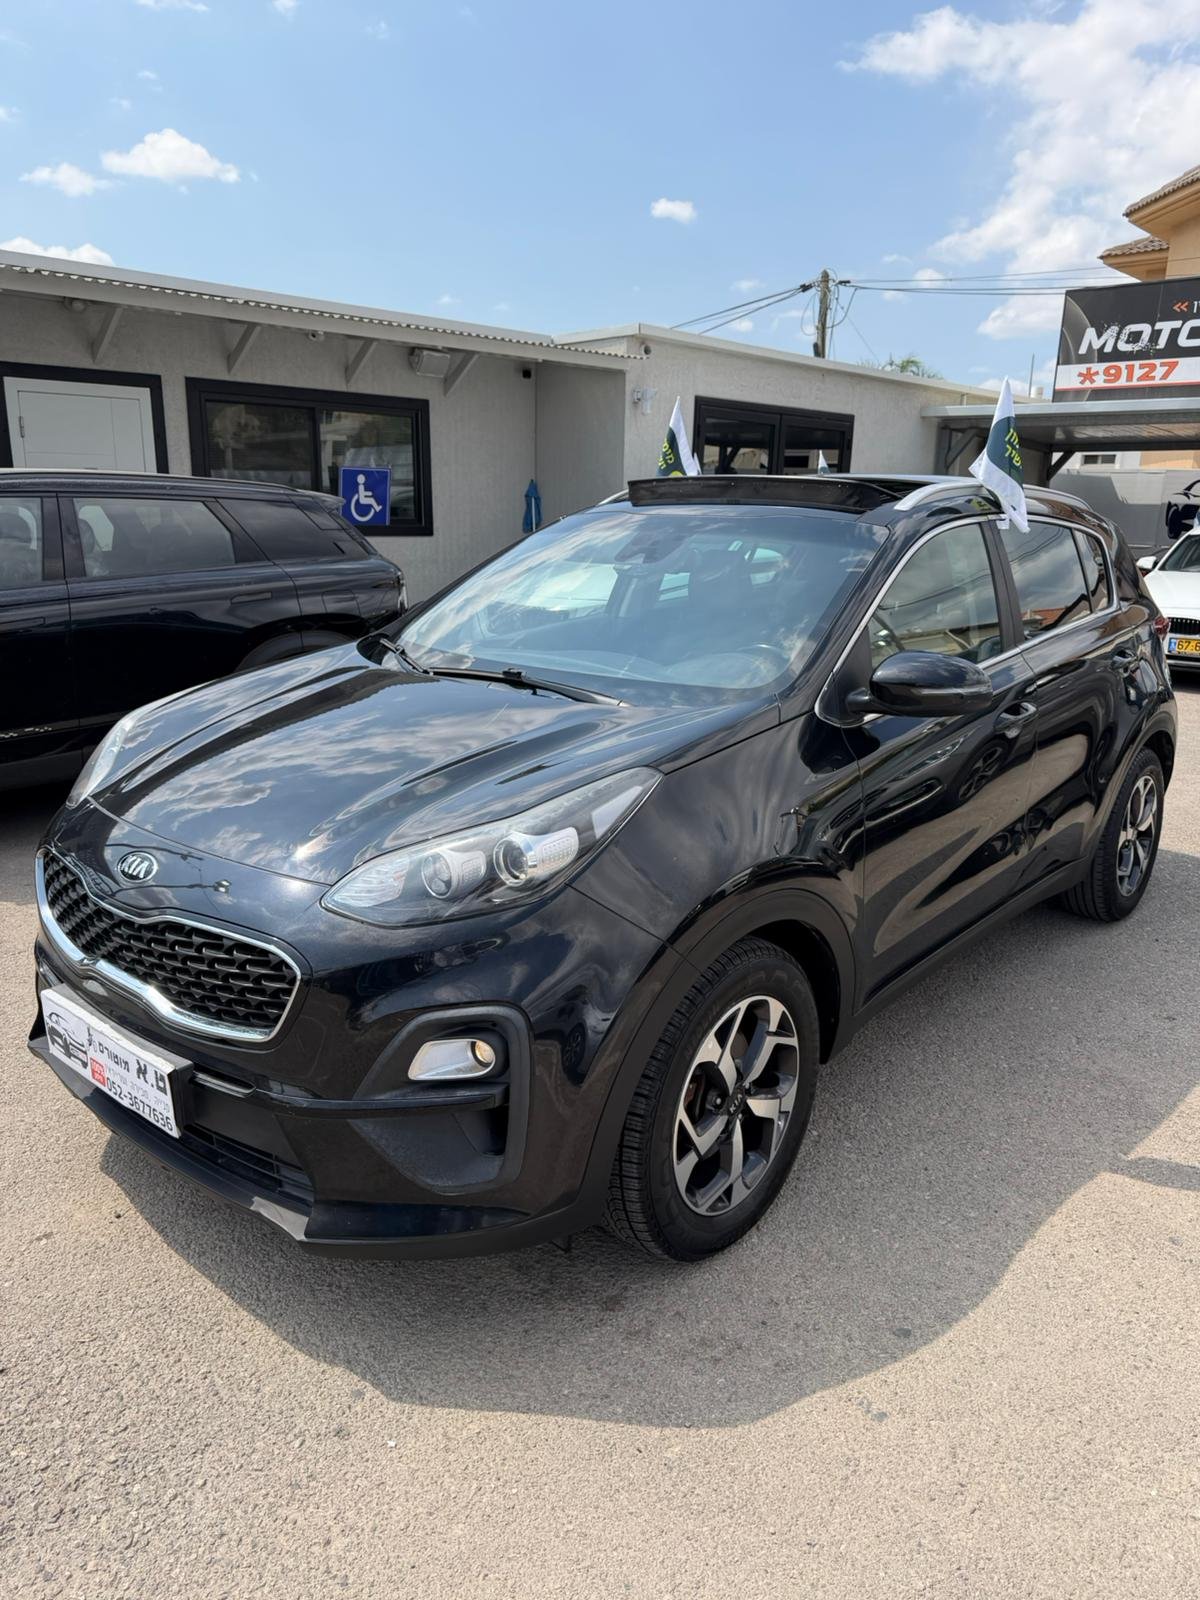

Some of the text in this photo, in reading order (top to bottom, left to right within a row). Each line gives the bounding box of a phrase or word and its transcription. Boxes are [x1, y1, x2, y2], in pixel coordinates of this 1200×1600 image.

[120, 854, 150, 879] KIA
[106, 1076, 173, 1132] 052-3677636
[729, 1093, 743, 1114] KIA
